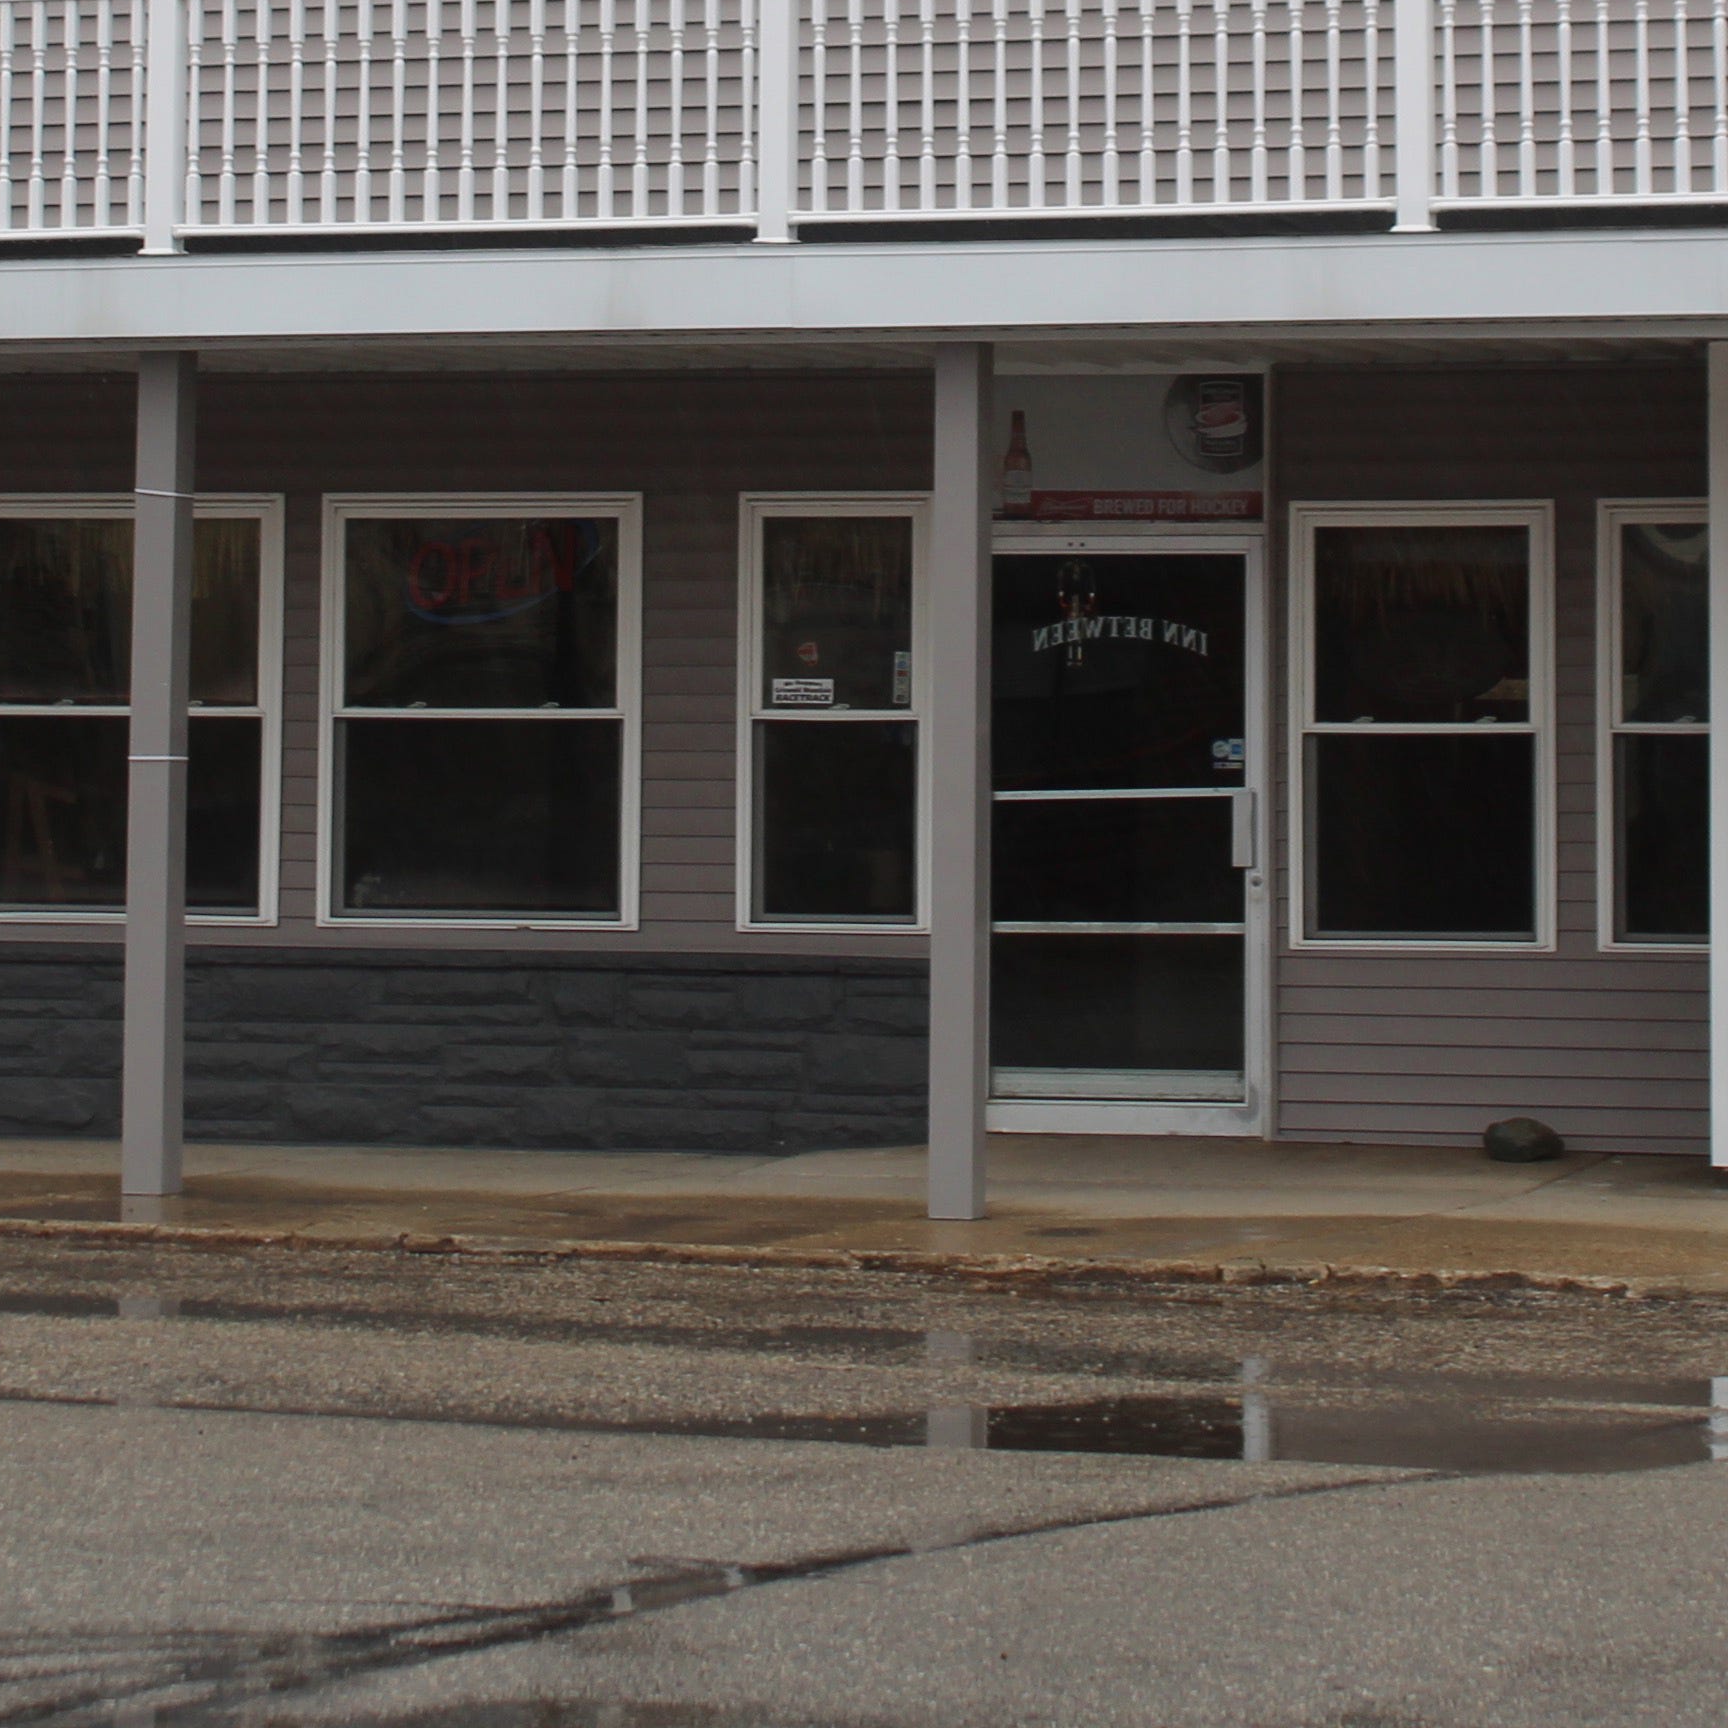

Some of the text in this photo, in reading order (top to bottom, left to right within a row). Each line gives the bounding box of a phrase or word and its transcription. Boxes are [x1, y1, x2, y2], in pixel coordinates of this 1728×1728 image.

[1093, 497, 1153, 515] BREWED
[1158, 497, 1187, 515] FOR
[1190, 497, 1248, 515] HOCKEY
